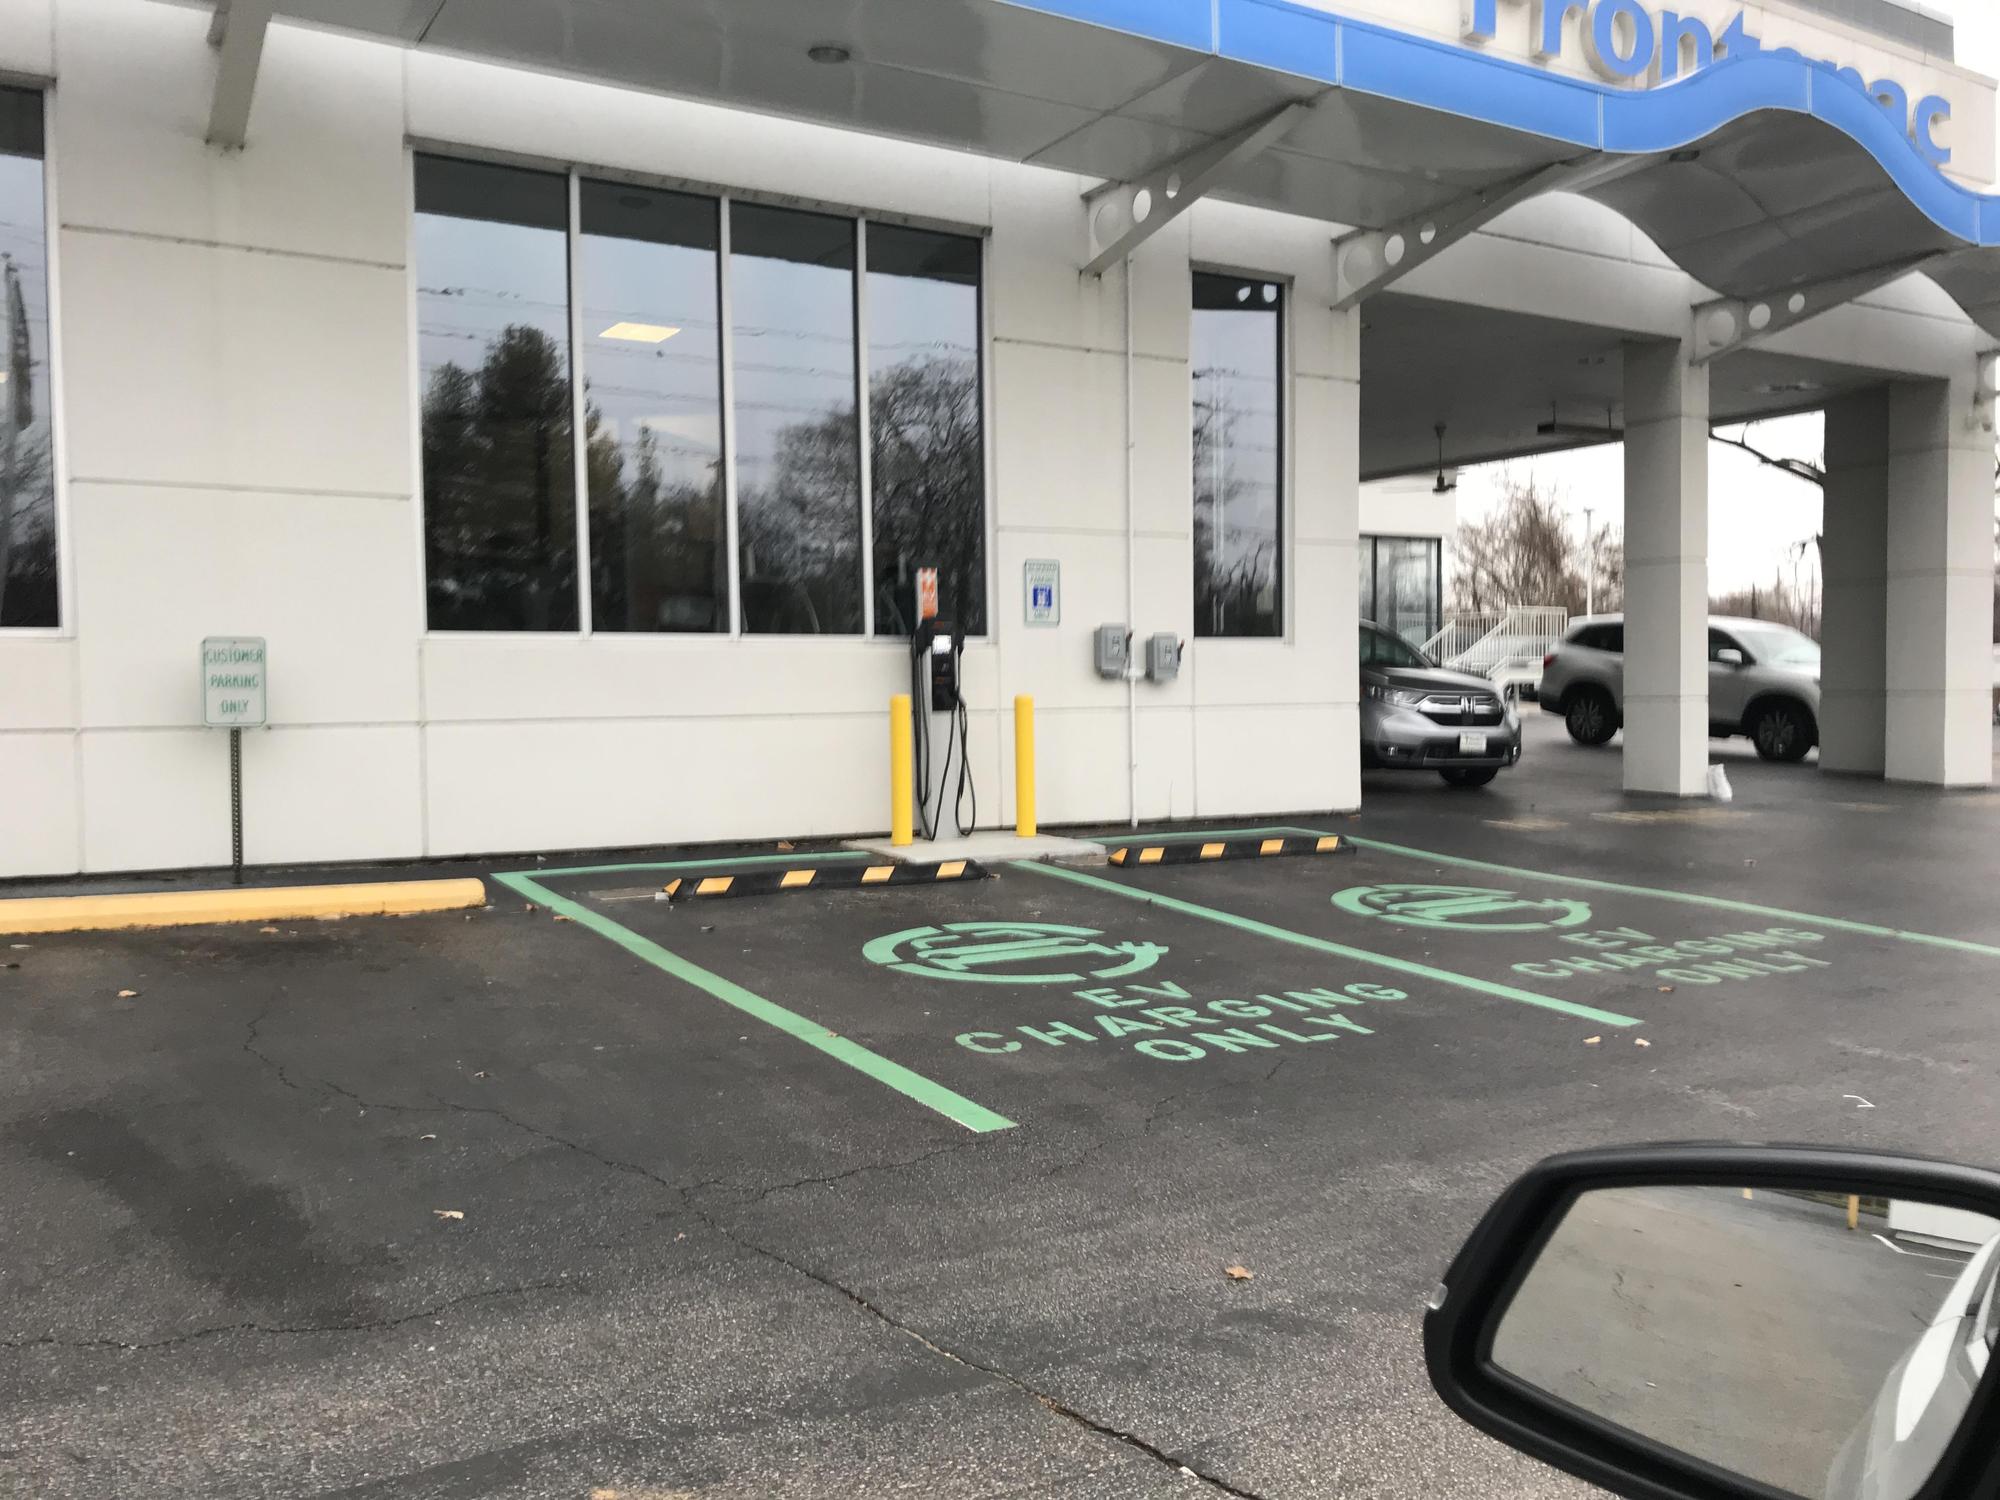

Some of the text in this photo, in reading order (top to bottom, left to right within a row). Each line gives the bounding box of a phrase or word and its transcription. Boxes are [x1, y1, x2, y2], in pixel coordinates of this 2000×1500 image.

[205, 648, 263, 662] CUSTOMER
[209, 674, 259, 688] PARKING
[221, 700, 248, 713] ONLY
[1558, 927, 1656, 948] EV
[1511, 927, 1825, 978] CHARGING
[1655, 950, 1833, 984] ONLY
[1073, 980, 1193, 1008] EV
[954, 982, 1408, 1054] CHARGING
[1133, 1013, 1376, 1061] ONLY
